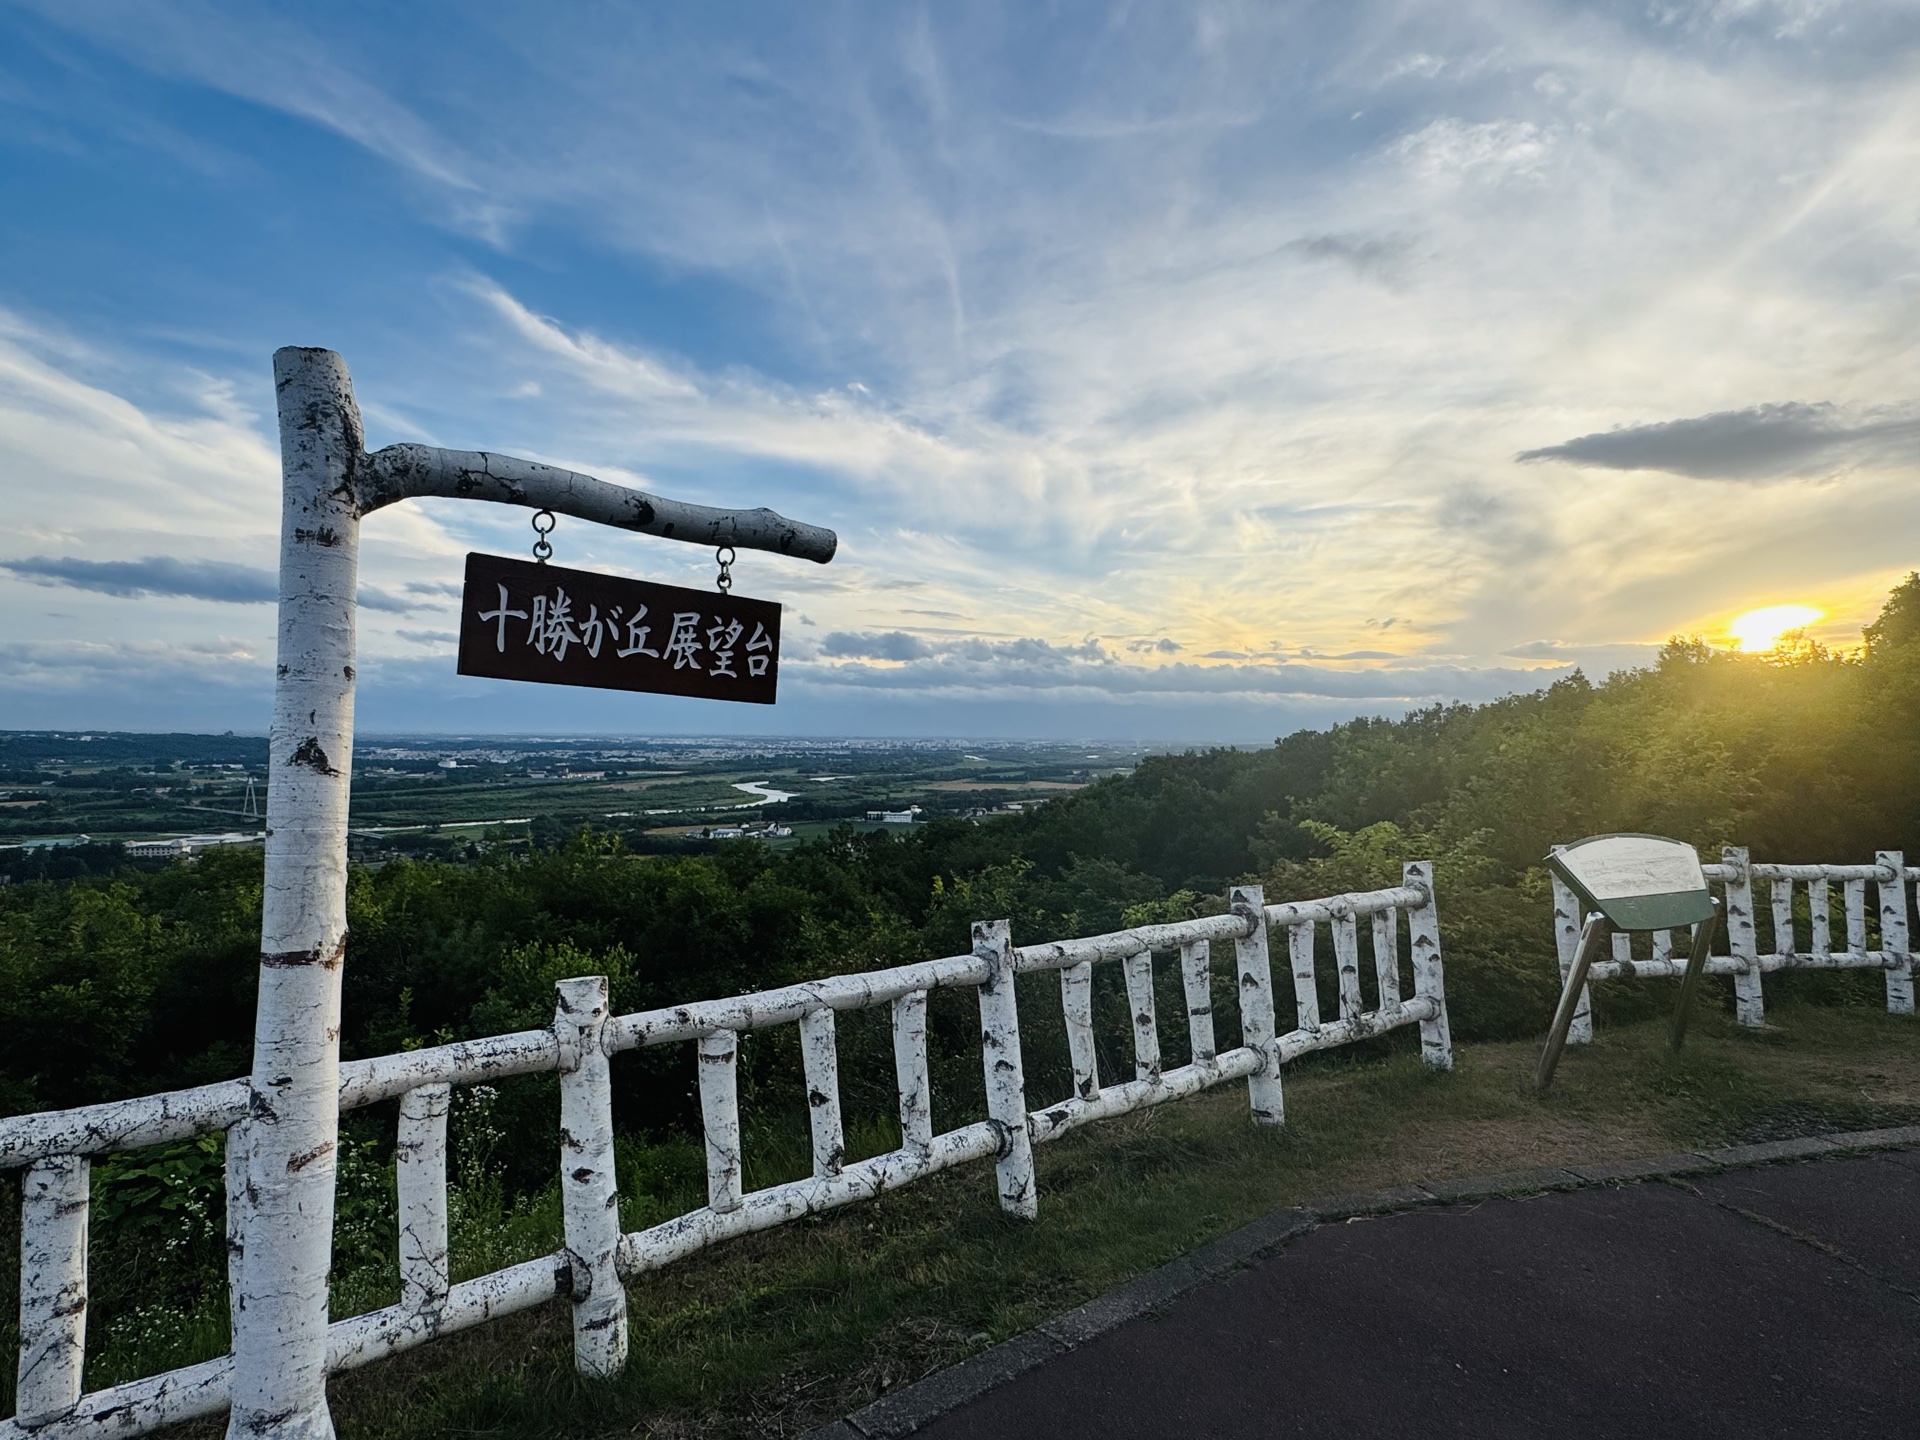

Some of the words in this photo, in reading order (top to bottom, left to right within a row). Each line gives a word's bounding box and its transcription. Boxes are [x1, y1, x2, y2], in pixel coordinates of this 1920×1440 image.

[477, 583, 773, 678] 十勝が丘展望台
